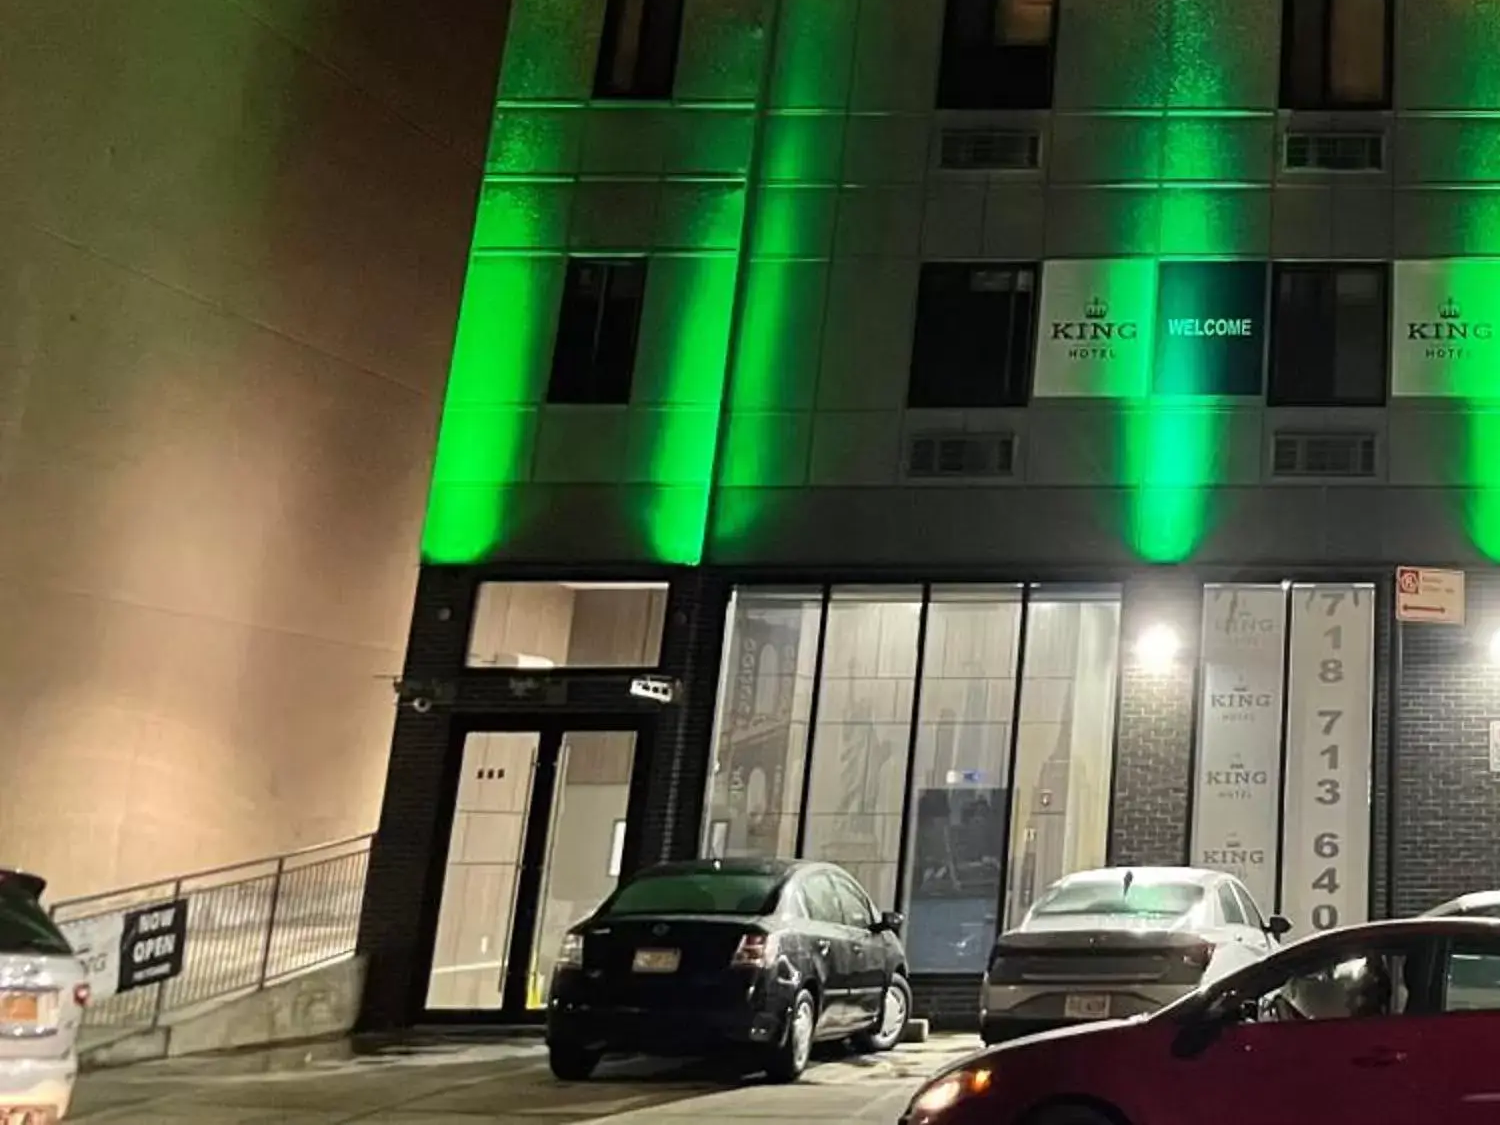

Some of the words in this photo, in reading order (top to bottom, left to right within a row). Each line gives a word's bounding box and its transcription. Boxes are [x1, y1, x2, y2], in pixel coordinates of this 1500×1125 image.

[1051, 322, 1138, 340] KING
[1167, 318, 1253, 337] WELCOME
[1407, 323, 1493, 340] KING
[1068, 347, 1117, 360] HOTEL
[1425, 348, 1471, 361] HOT
[1211, 693, 1272, 708] KING
[1206, 770, 1267, 786] KING
[1203, 849, 1265, 865] KING
[138, 907, 176, 935] NOW
[133, 933, 177, 964] OPEN
